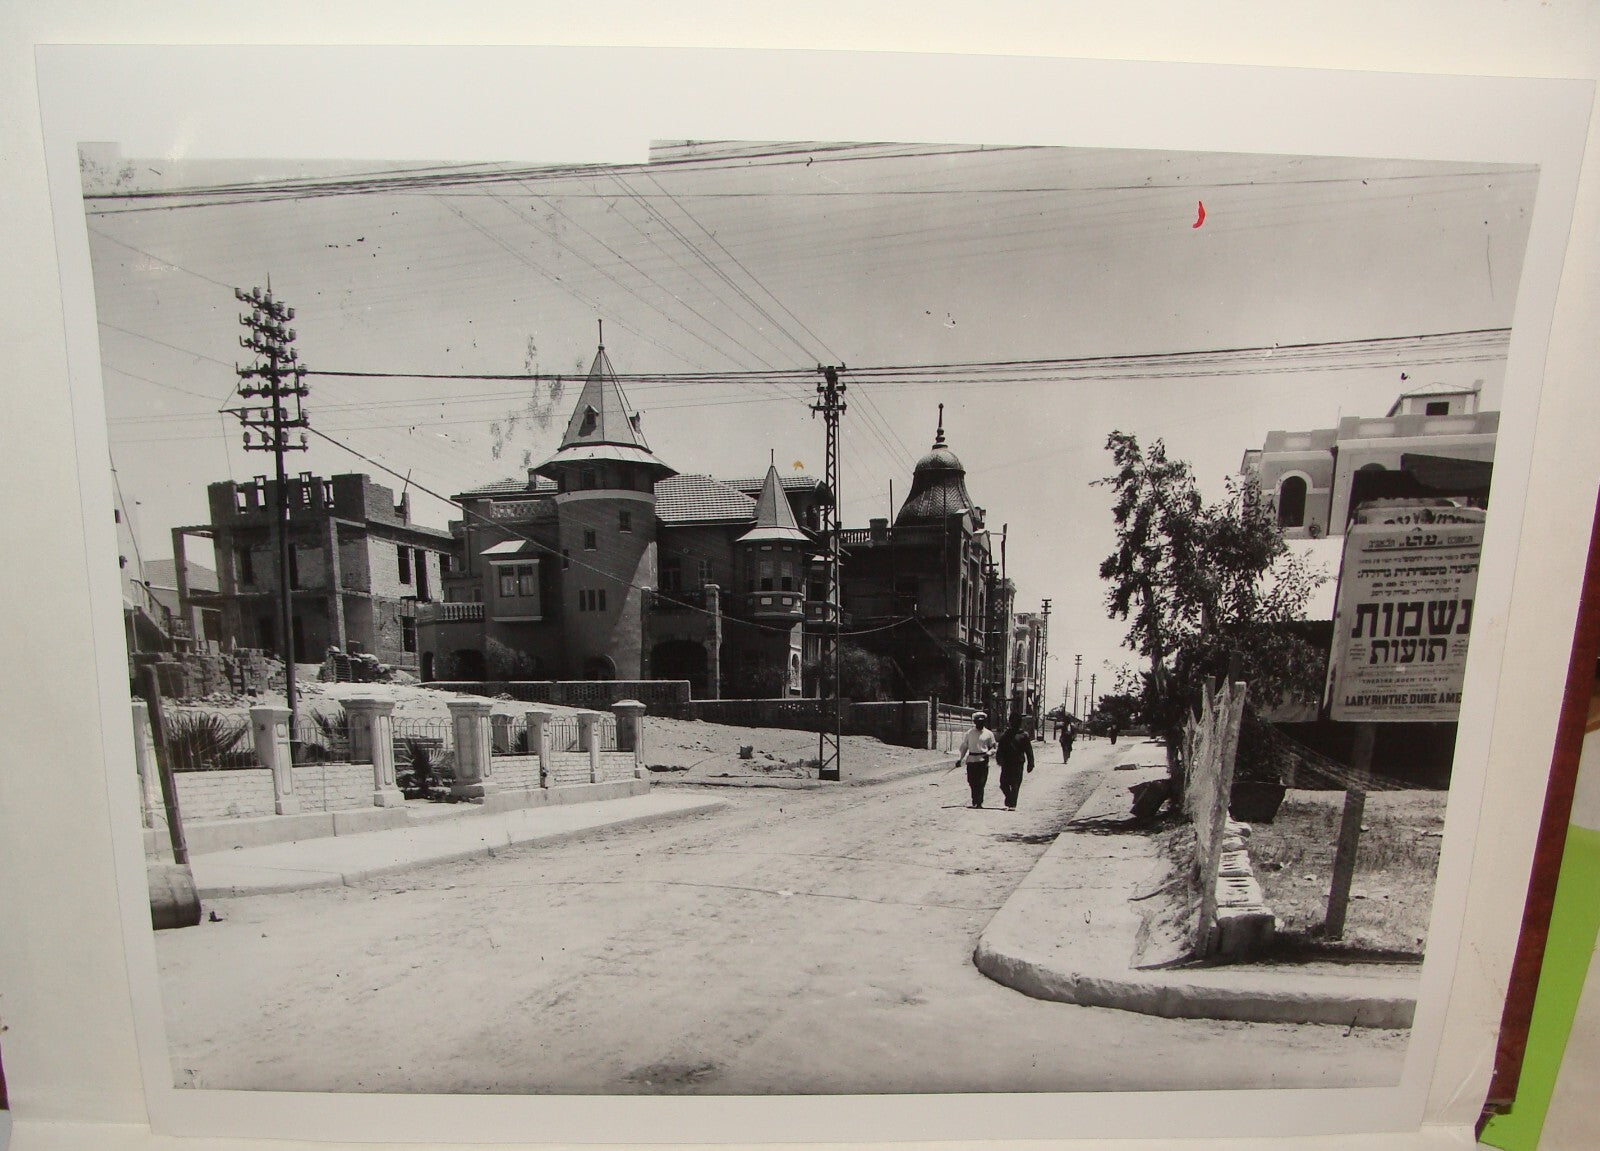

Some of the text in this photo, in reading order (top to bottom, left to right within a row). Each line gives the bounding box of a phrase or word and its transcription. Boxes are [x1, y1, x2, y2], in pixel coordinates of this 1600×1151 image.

[1351, 599, 1474, 638] נשמות
[1369, 637, 1448, 664] תועות
[1345, 692, 1408, 706] LABYRINTHE
